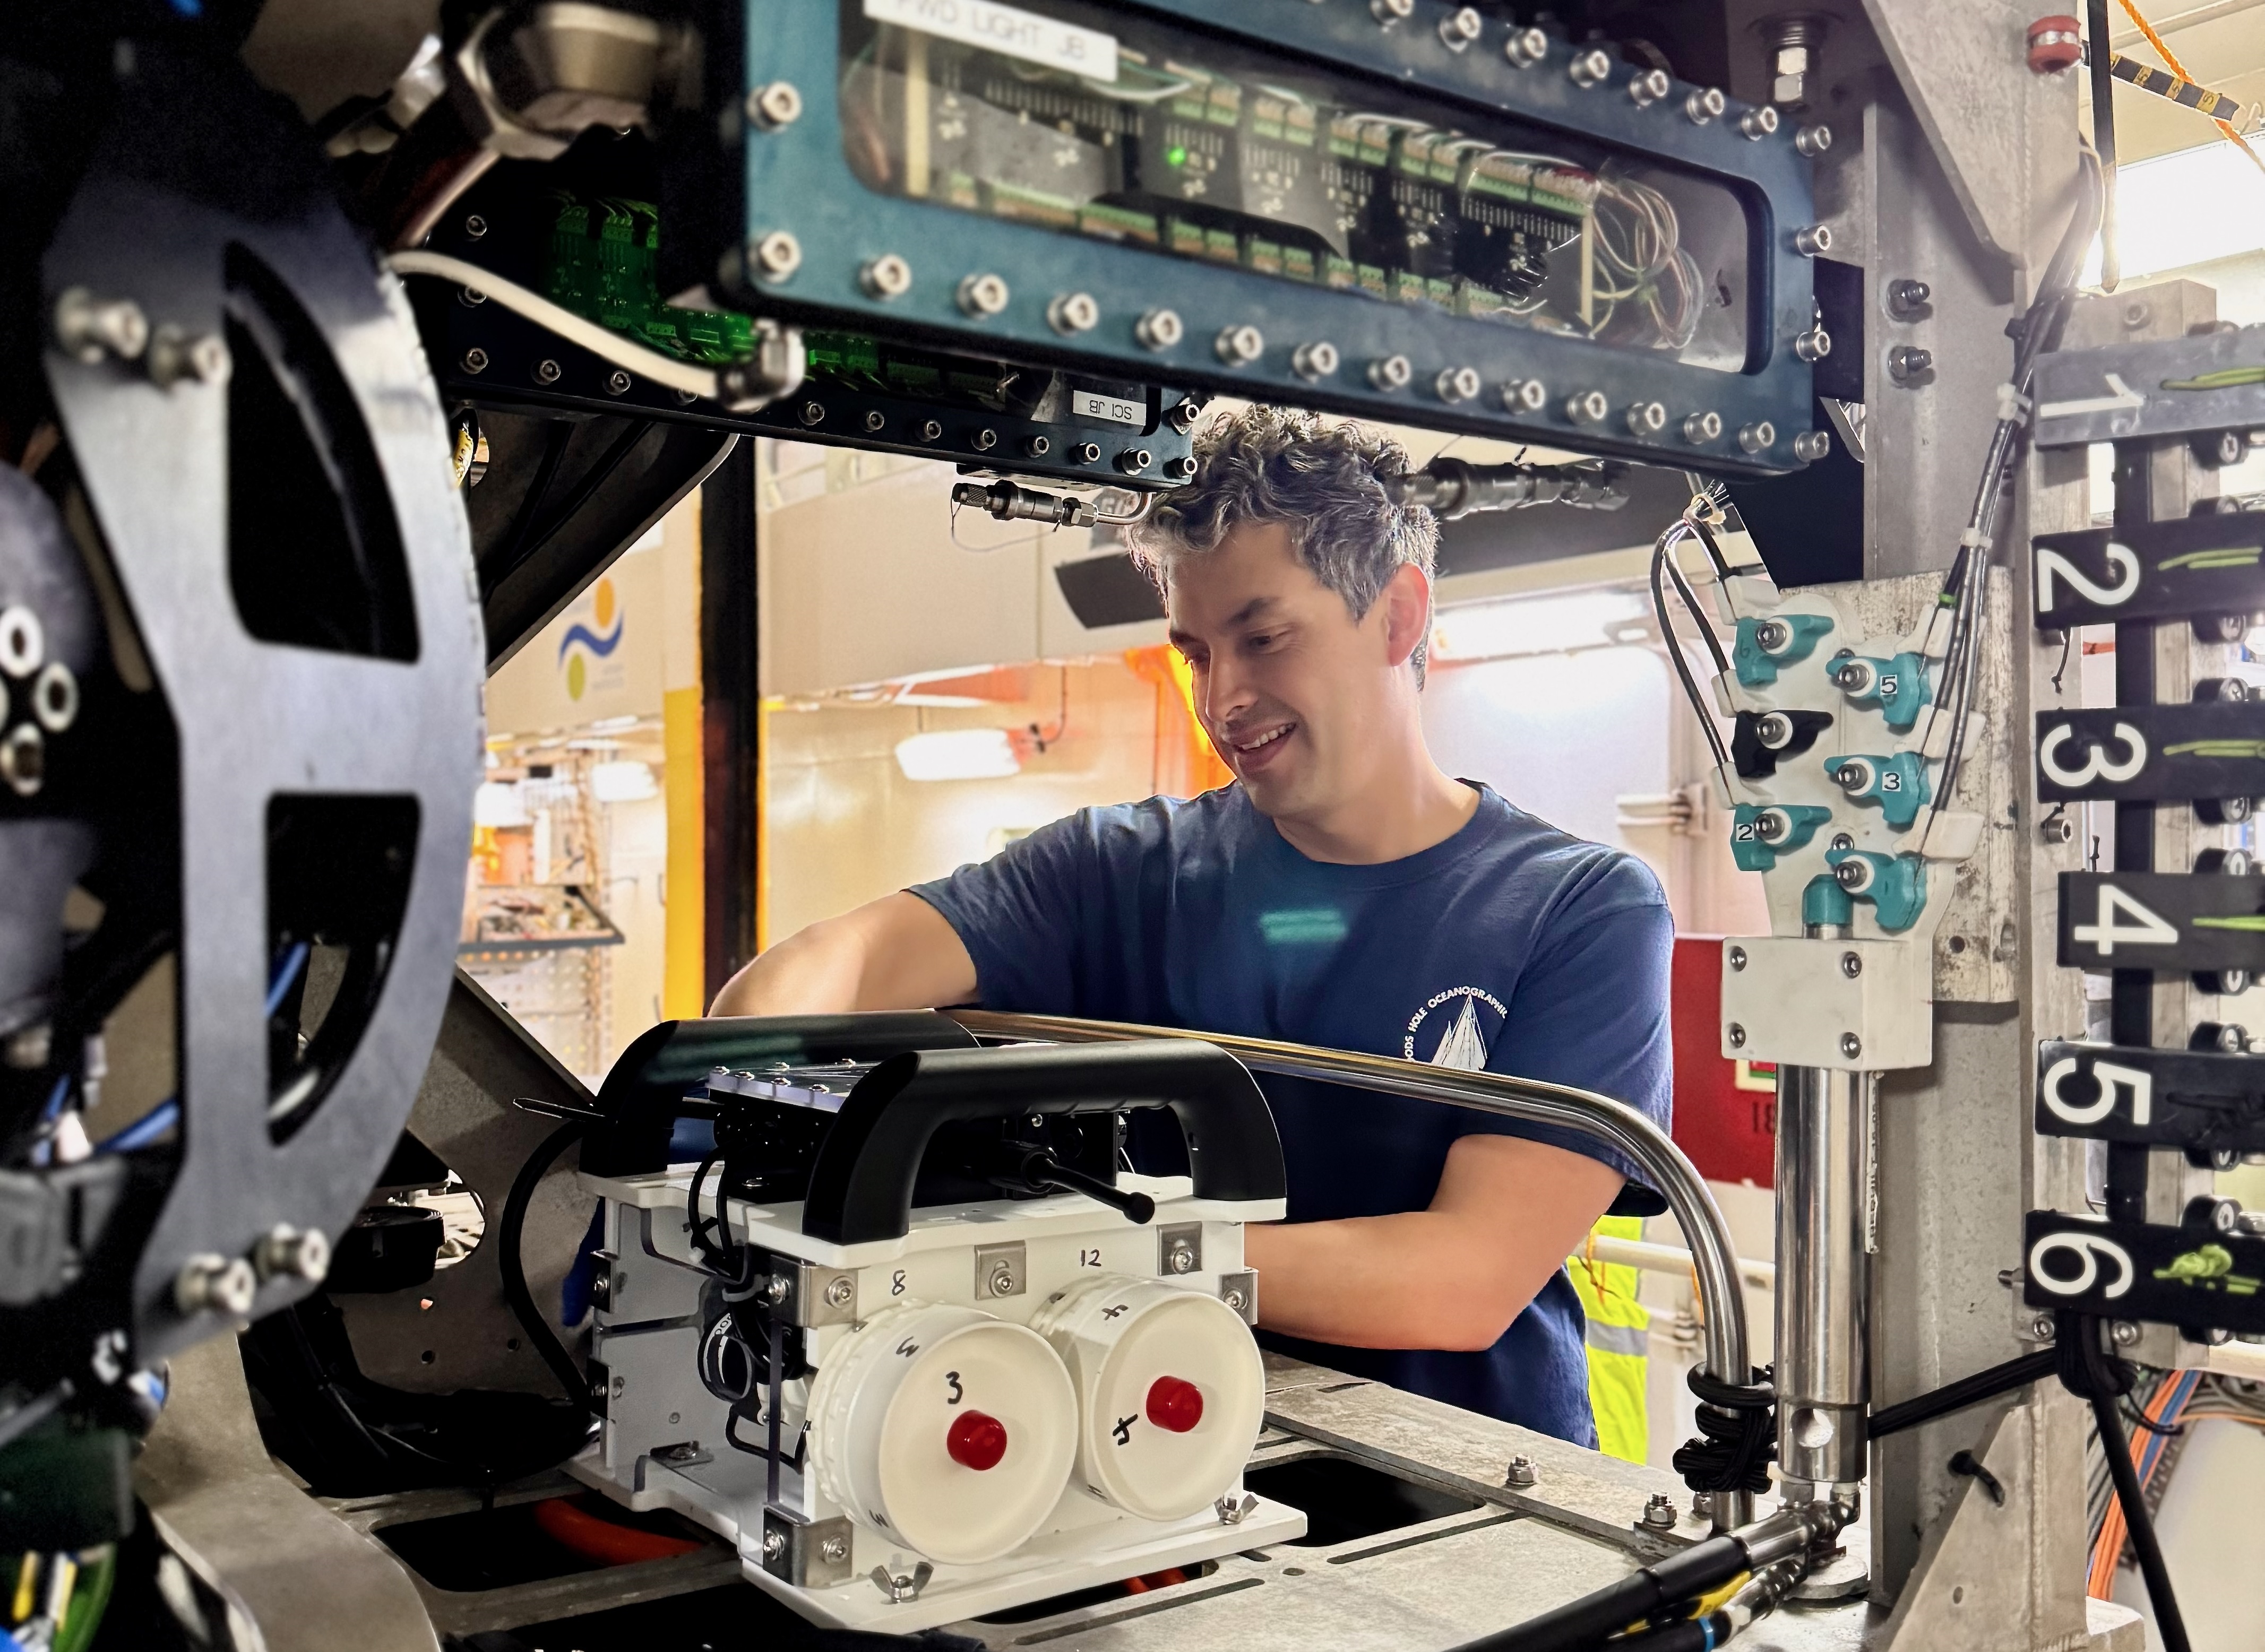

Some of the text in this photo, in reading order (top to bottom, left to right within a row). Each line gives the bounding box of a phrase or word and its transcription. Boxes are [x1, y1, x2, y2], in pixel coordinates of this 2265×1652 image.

[972, 7, 1045, 48] LIGHT
[1055, 34, 1086, 60] JB
[1089, 400, 1132, 420] SCI JB
[2040, 374, 2144, 417] 1
[2037, 543, 2140, 612] 2
[1881, 676, 1897, 694] 5
[2040, 723, 2147, 787] 3
[1884, 772, 1900, 790] 3
[1738, 824, 1753, 841] 2
[2074, 884, 2178, 955] 4
[1408, 1007, 1428, 1032] HOLE
[2044, 1058, 2151, 1125] 5
[1080, 1249, 1101, 1267] 12
[2030, 1233, 2133, 1298] 6
[891, 1269, 906, 1296] 8
[946, 1371, 963, 1404] 3
